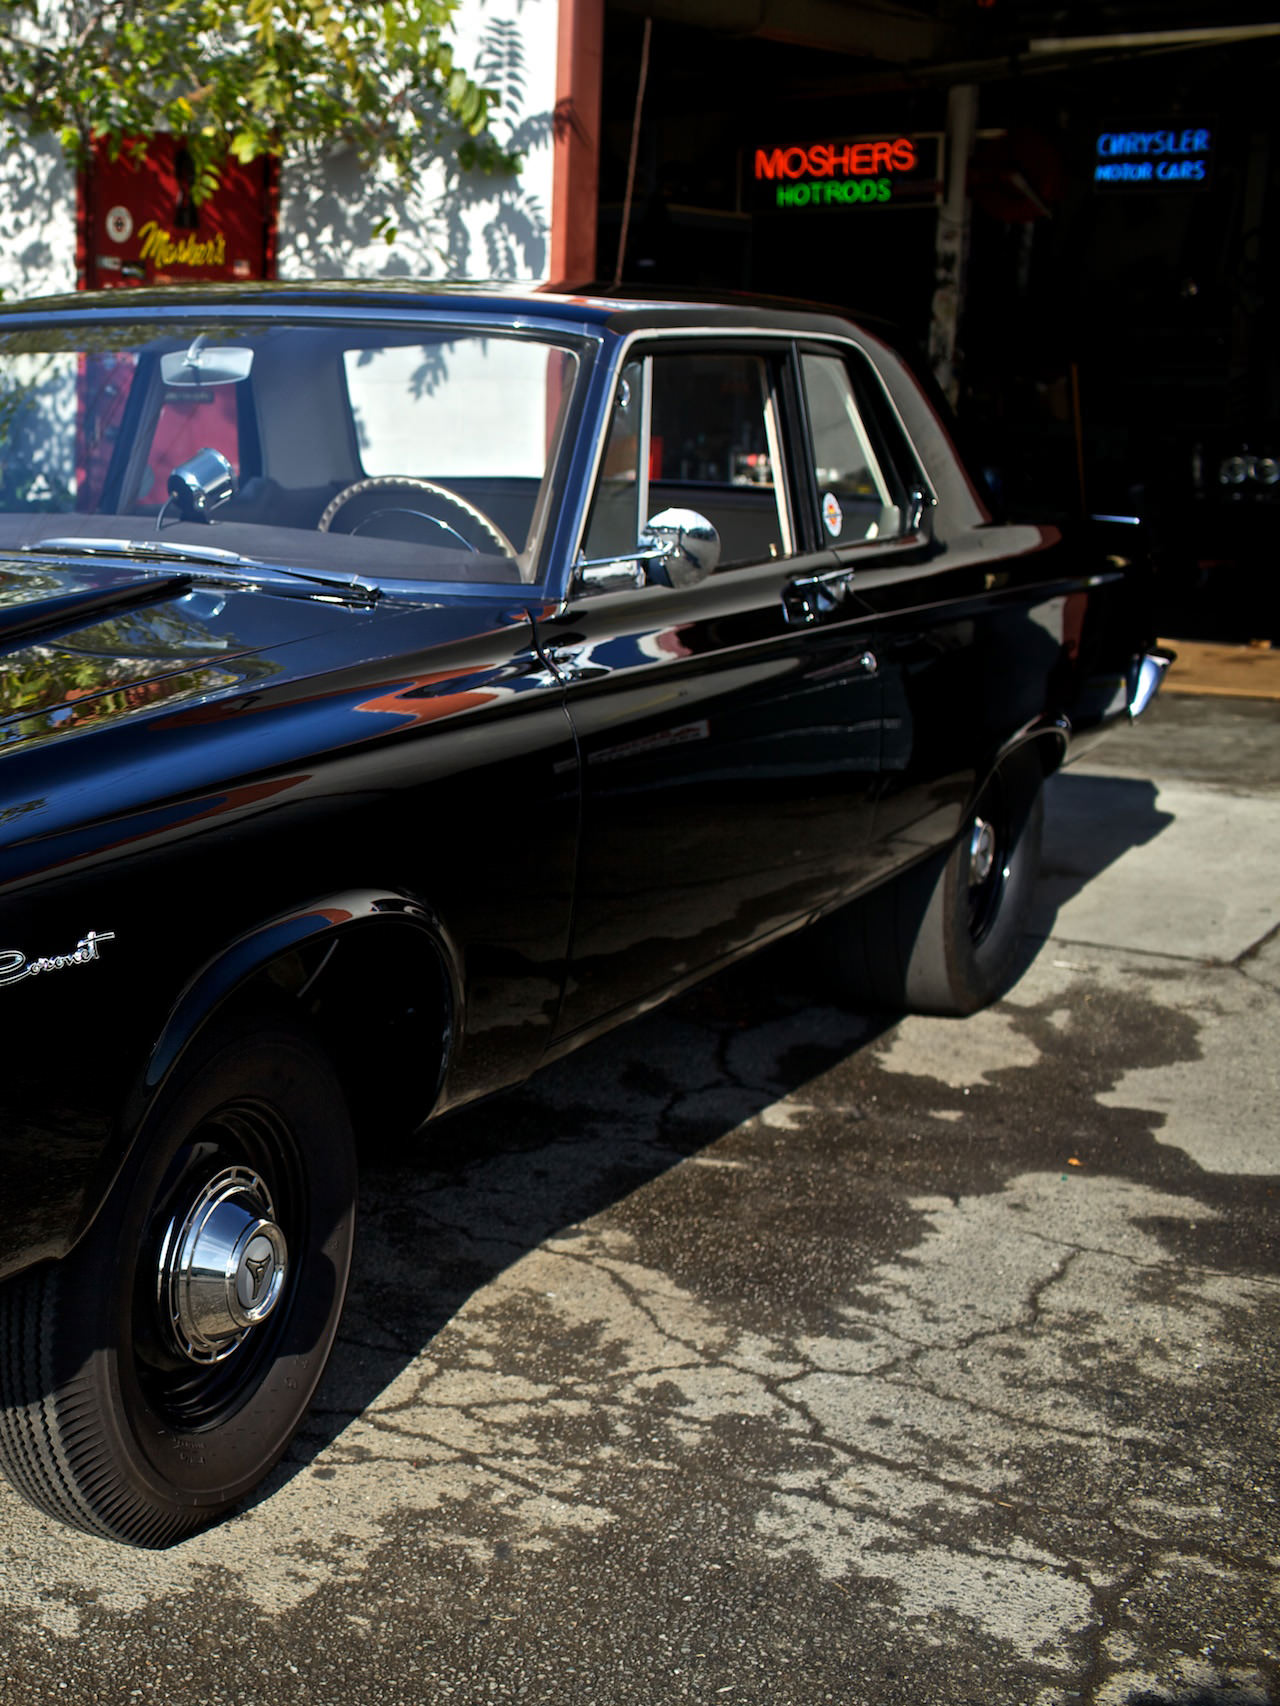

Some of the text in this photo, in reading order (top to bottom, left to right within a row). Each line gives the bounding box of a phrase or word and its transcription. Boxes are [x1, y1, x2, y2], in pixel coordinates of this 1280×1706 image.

[1096, 128, 1210, 157] CHRYSLER
[755, 138, 916, 180] MOSHERS
[1156, 160, 1206, 181] CARS
